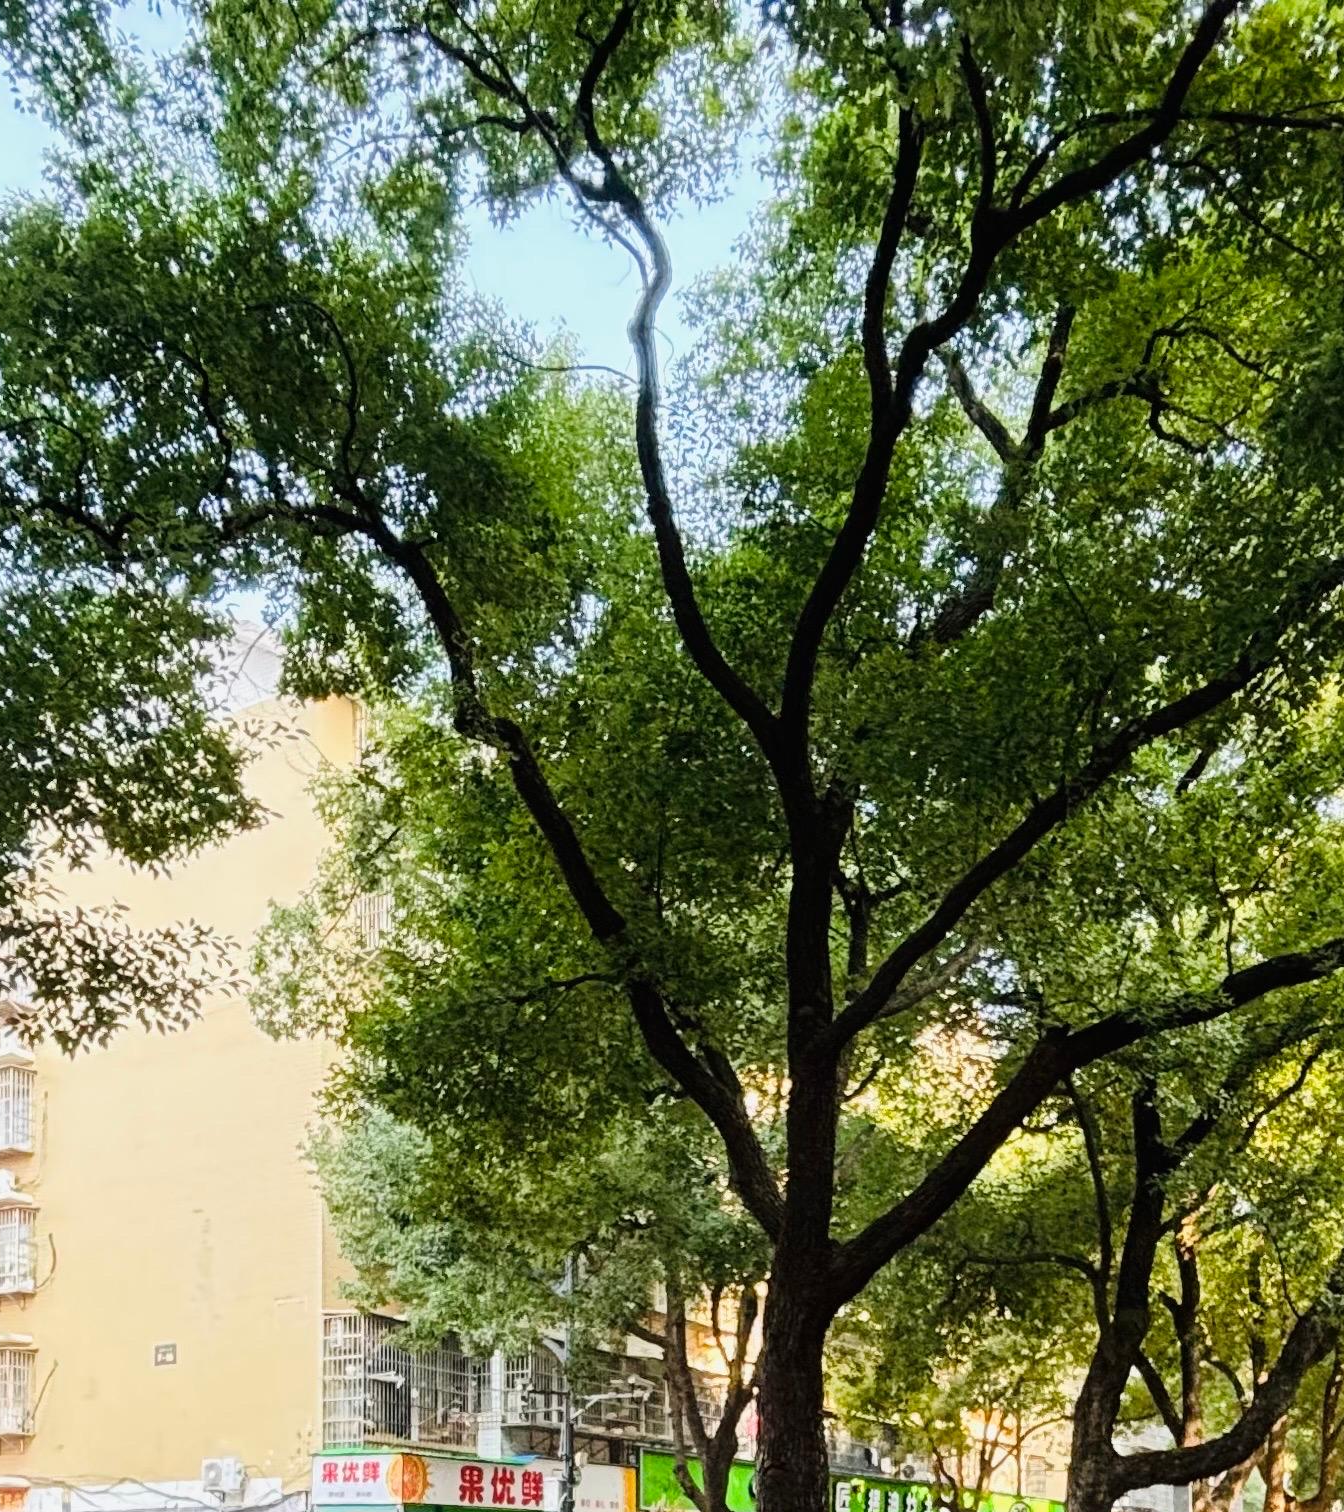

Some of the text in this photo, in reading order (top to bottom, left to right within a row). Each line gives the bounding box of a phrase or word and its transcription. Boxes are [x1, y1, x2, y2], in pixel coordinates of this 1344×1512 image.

[322, 1461, 381, 1483] 果优鲜
[459, 1465, 544, 1507] 果优鲜
